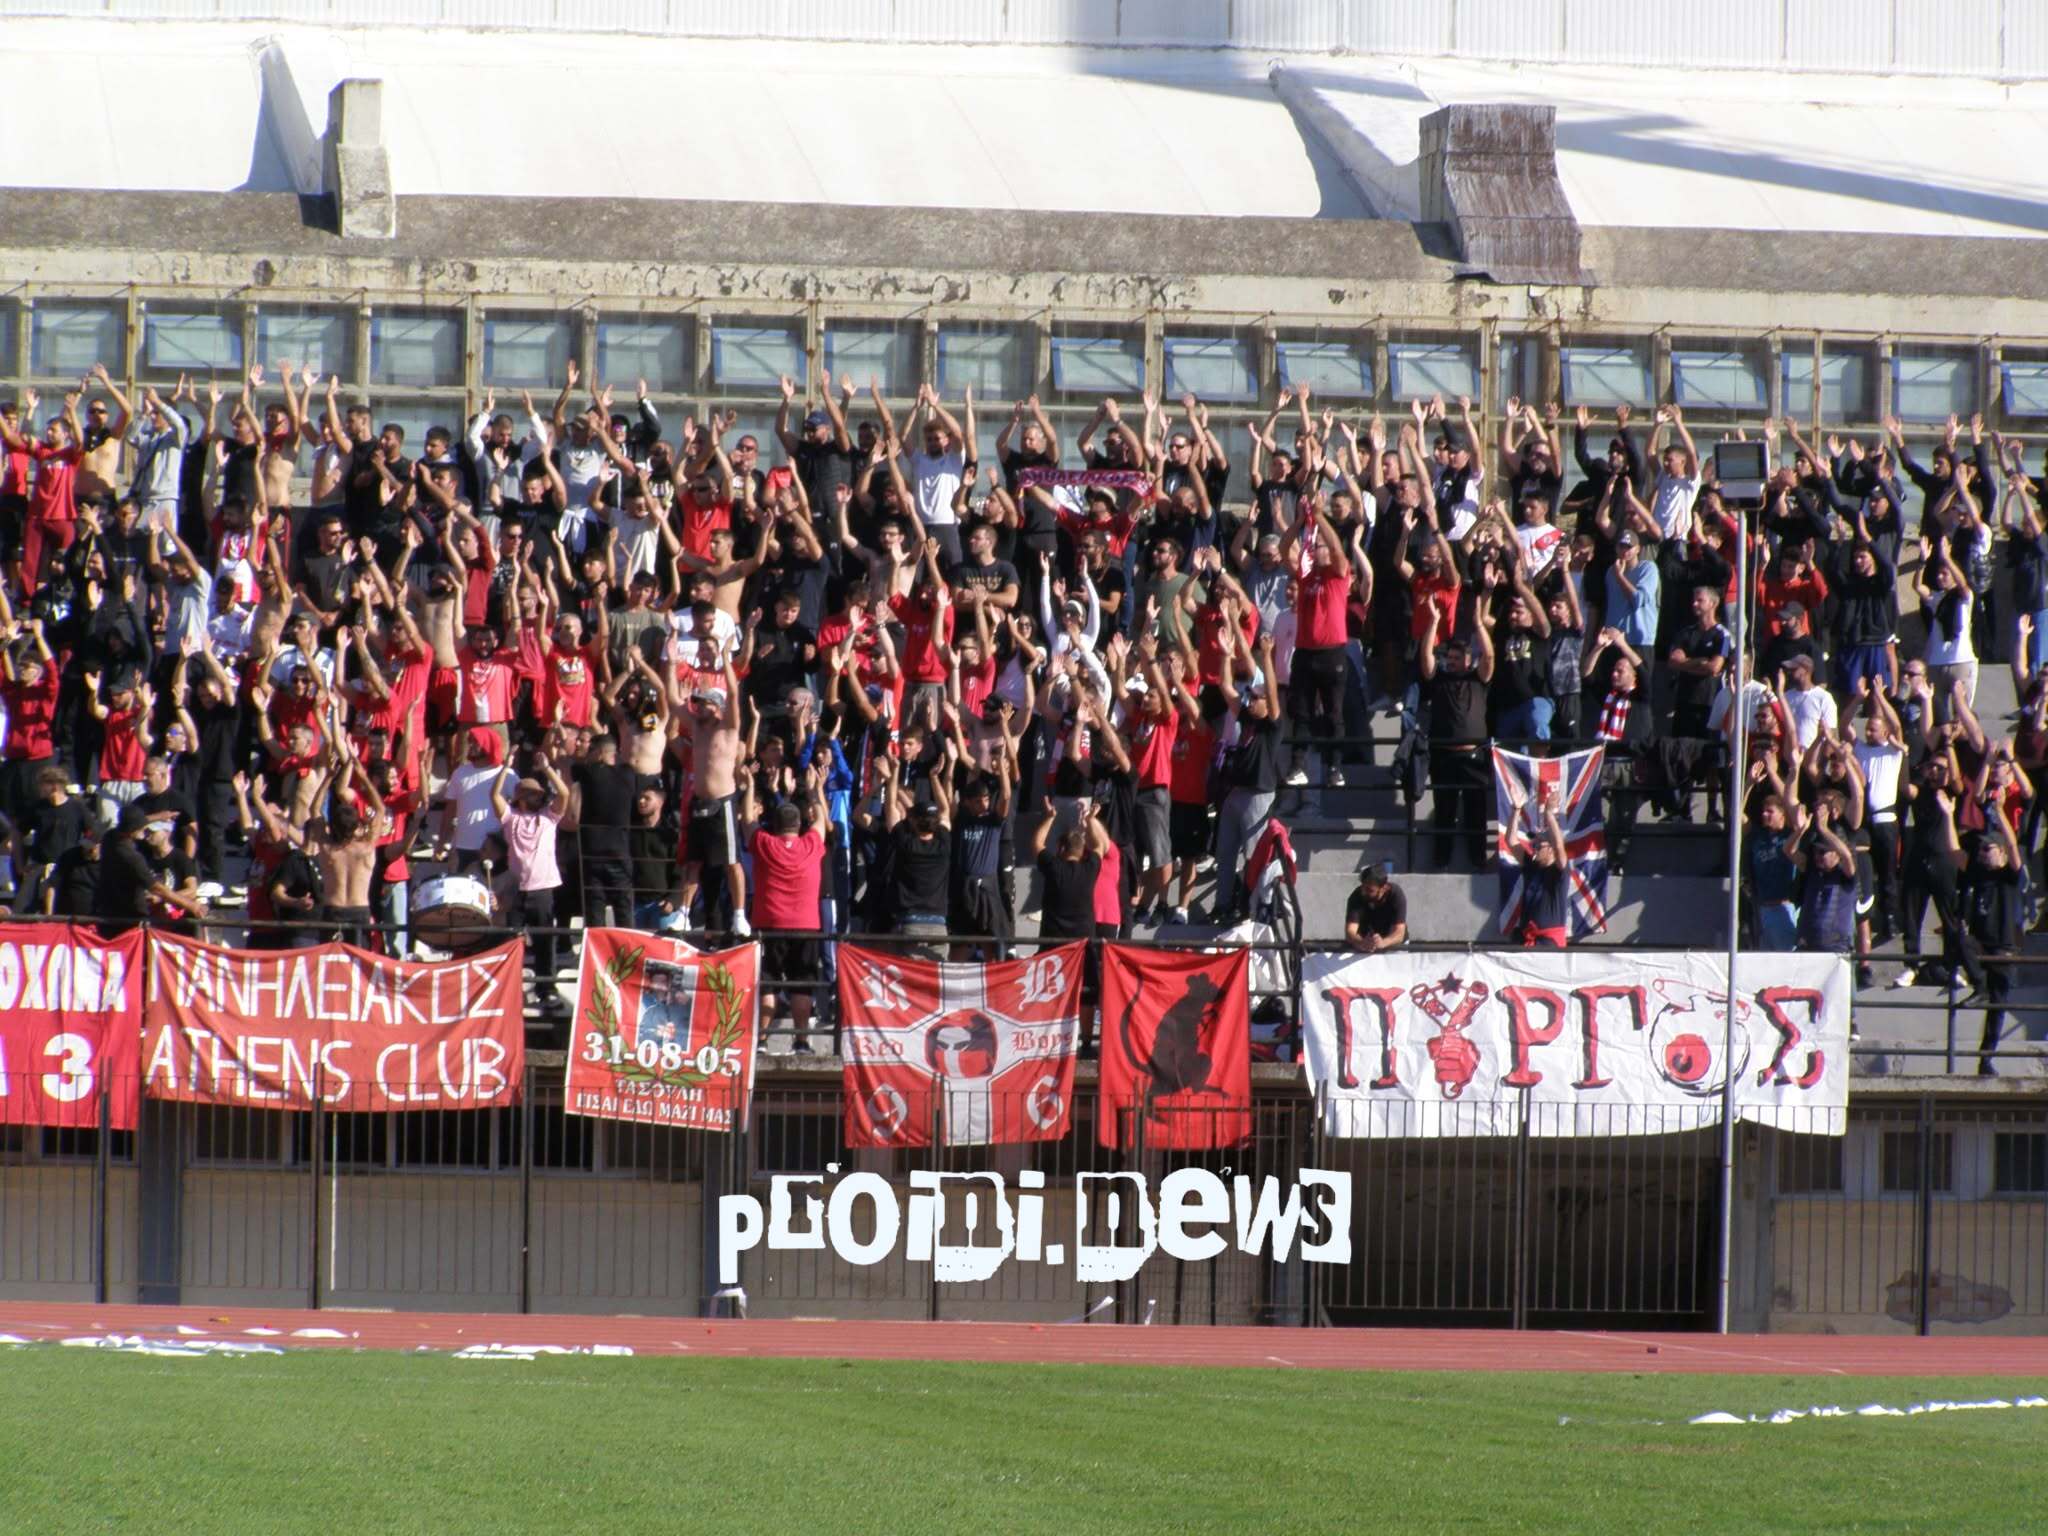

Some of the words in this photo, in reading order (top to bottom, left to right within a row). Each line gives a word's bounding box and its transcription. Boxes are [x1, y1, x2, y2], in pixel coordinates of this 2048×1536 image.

[150, 938, 508, 1025] ΠΑΝΗΛΕΙΑΚΟΣ
[42, 1033, 94, 1101] 3
[145, 1023, 353, 1103] ATHENS
[376, 1037, 508, 1102] CLUB
[583, 1031, 743, 1077] 31-08-05
